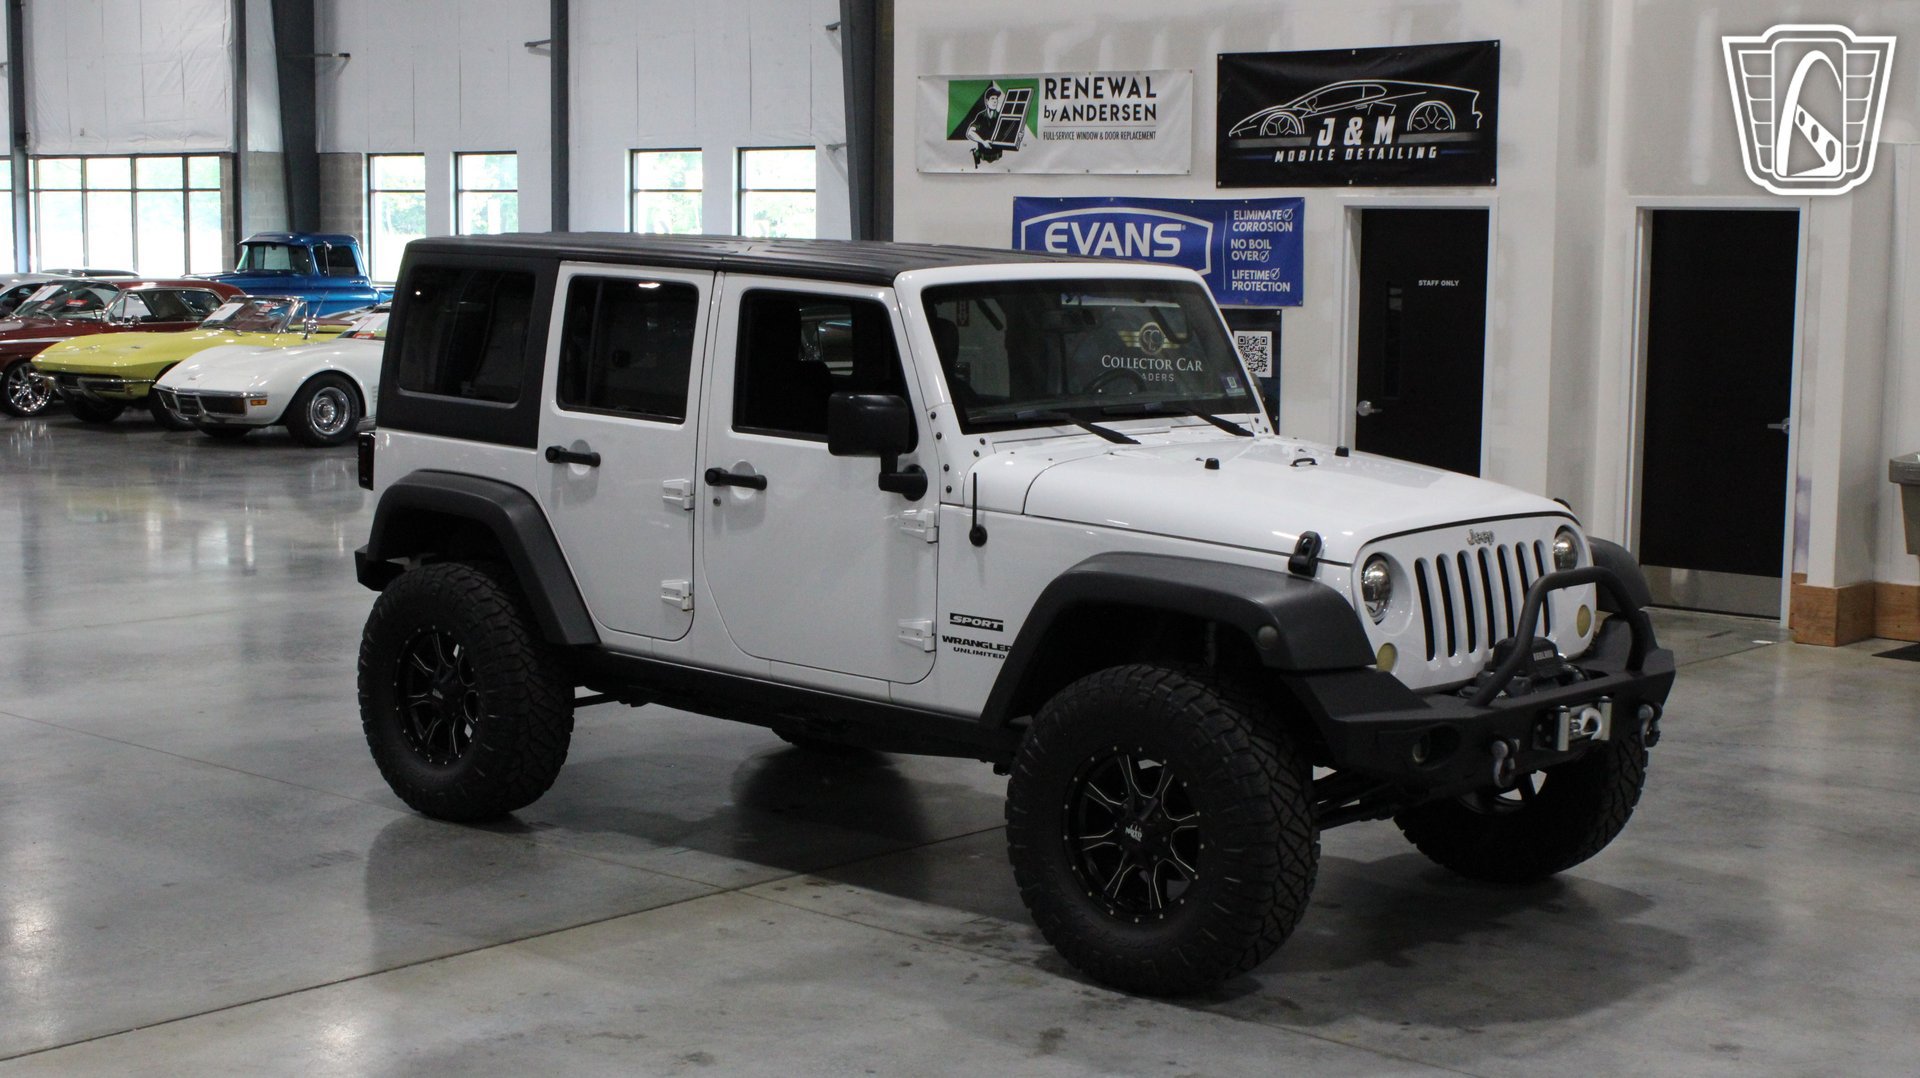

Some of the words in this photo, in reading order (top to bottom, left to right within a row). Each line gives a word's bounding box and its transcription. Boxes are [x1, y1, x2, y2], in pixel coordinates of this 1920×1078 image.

[1045, 76, 1157, 99] RENEWAL
[1044, 105, 1057, 121] by
[1060, 104, 1157, 121] ANDERSEN
[1076, 132, 1099, 140] WINDOW
[1104, 132, 1119, 140] DOOR
[1120, 131, 1156, 140] REPLACEMENT
[1317, 118, 1336, 146] J
[1343, 117, 1363, 145] &
[1373, 116, 1396, 145] M
[1274, 149, 1335, 163] MOBILE
[1344, 146, 1437, 161] DETAILING
[1233, 210, 1282, 220] ELIMINATE
[1232, 221, 1293, 232] CORROSION
[1044, 222, 1182, 257] EVANS
[1230, 239, 1246, 249] NO
[1249, 239, 1272, 249] BOIL
[1231, 250, 1259, 261] OVER
[1231, 269, 1270, 280] LIFETIME
[1231, 281, 1290, 292] PROTECTION
[1418, 279, 1439, 287] STAFF
[1440, 279, 1460, 287] ONLY
[1467, 529, 1495, 546] Jeep
[951, 614, 1003, 630] SPORT
[953, 646, 1006, 660] UNLIMITED
